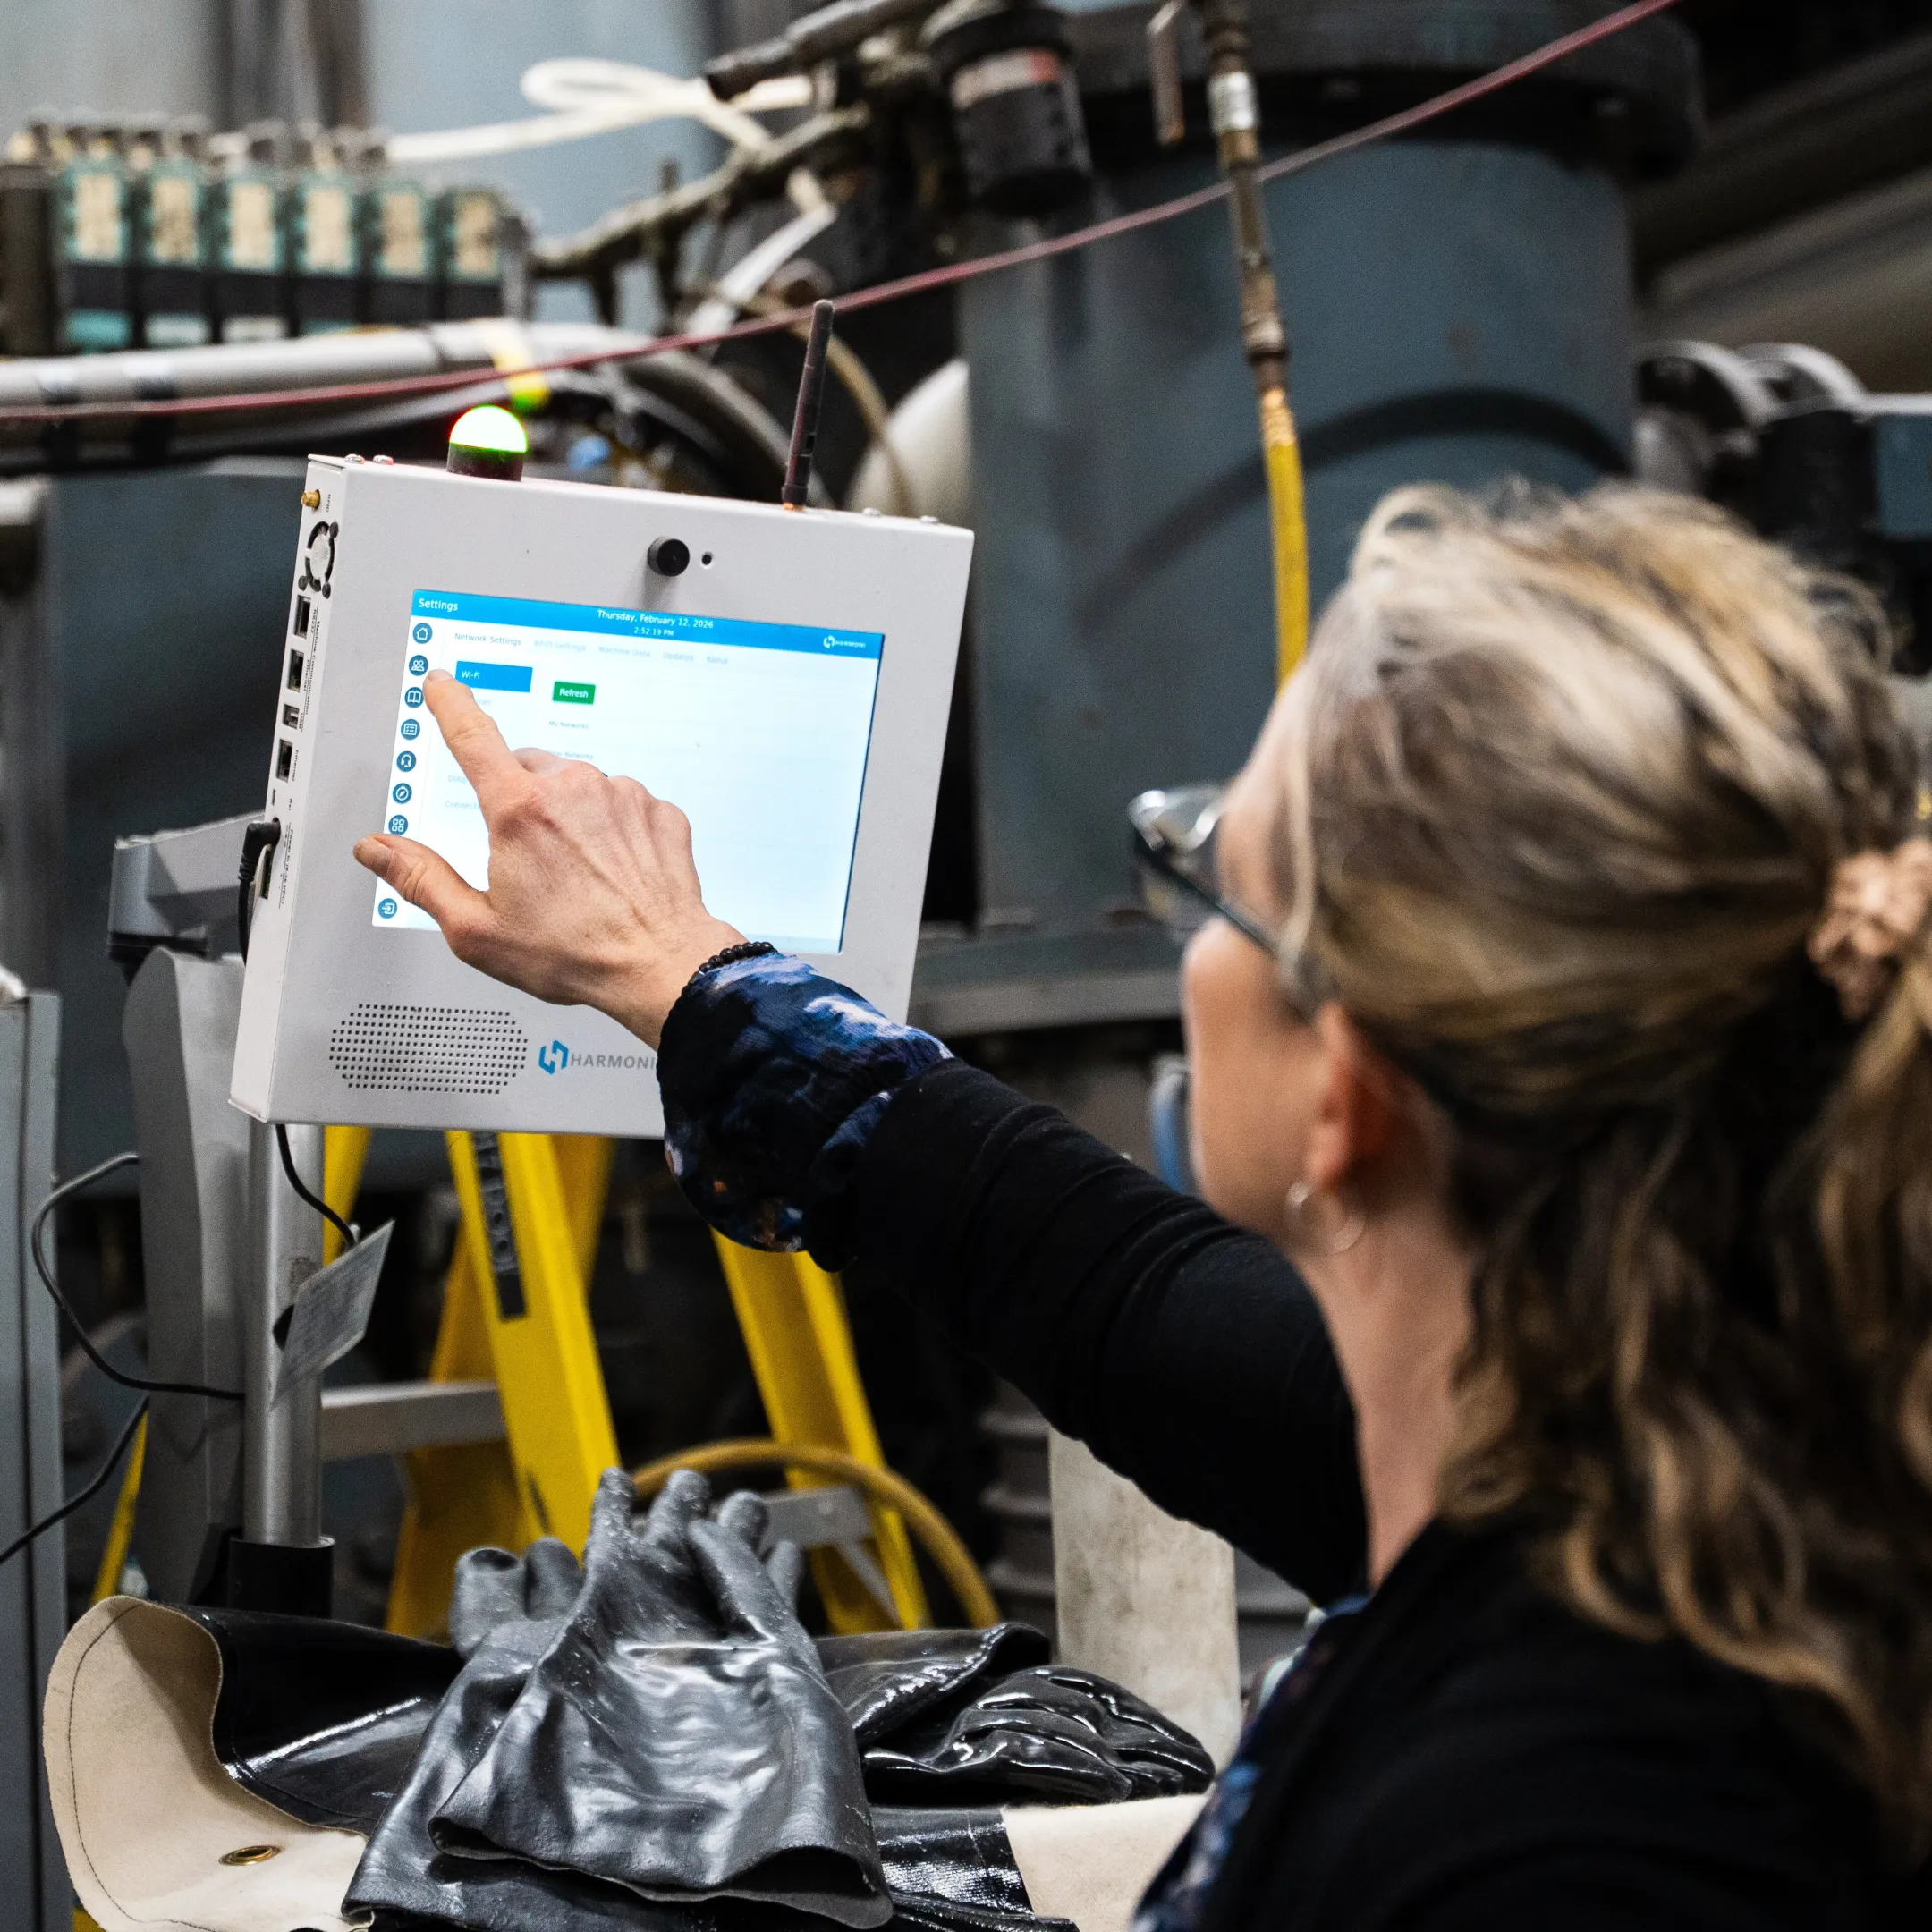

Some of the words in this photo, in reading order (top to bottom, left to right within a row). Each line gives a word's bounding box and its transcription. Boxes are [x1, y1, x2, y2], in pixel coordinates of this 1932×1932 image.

[419, 598, 458, 612] Settings
[640, 614, 675, 626] February
[693, 620, 714, 629] 2026
[454, 632, 487, 642] Network
[490, 636, 521, 646] Settings
[461, 671, 480, 680] Wi-Fi
[559, 688, 589, 699] Refresh
[571, 1053, 656, 1070] HARMONI
